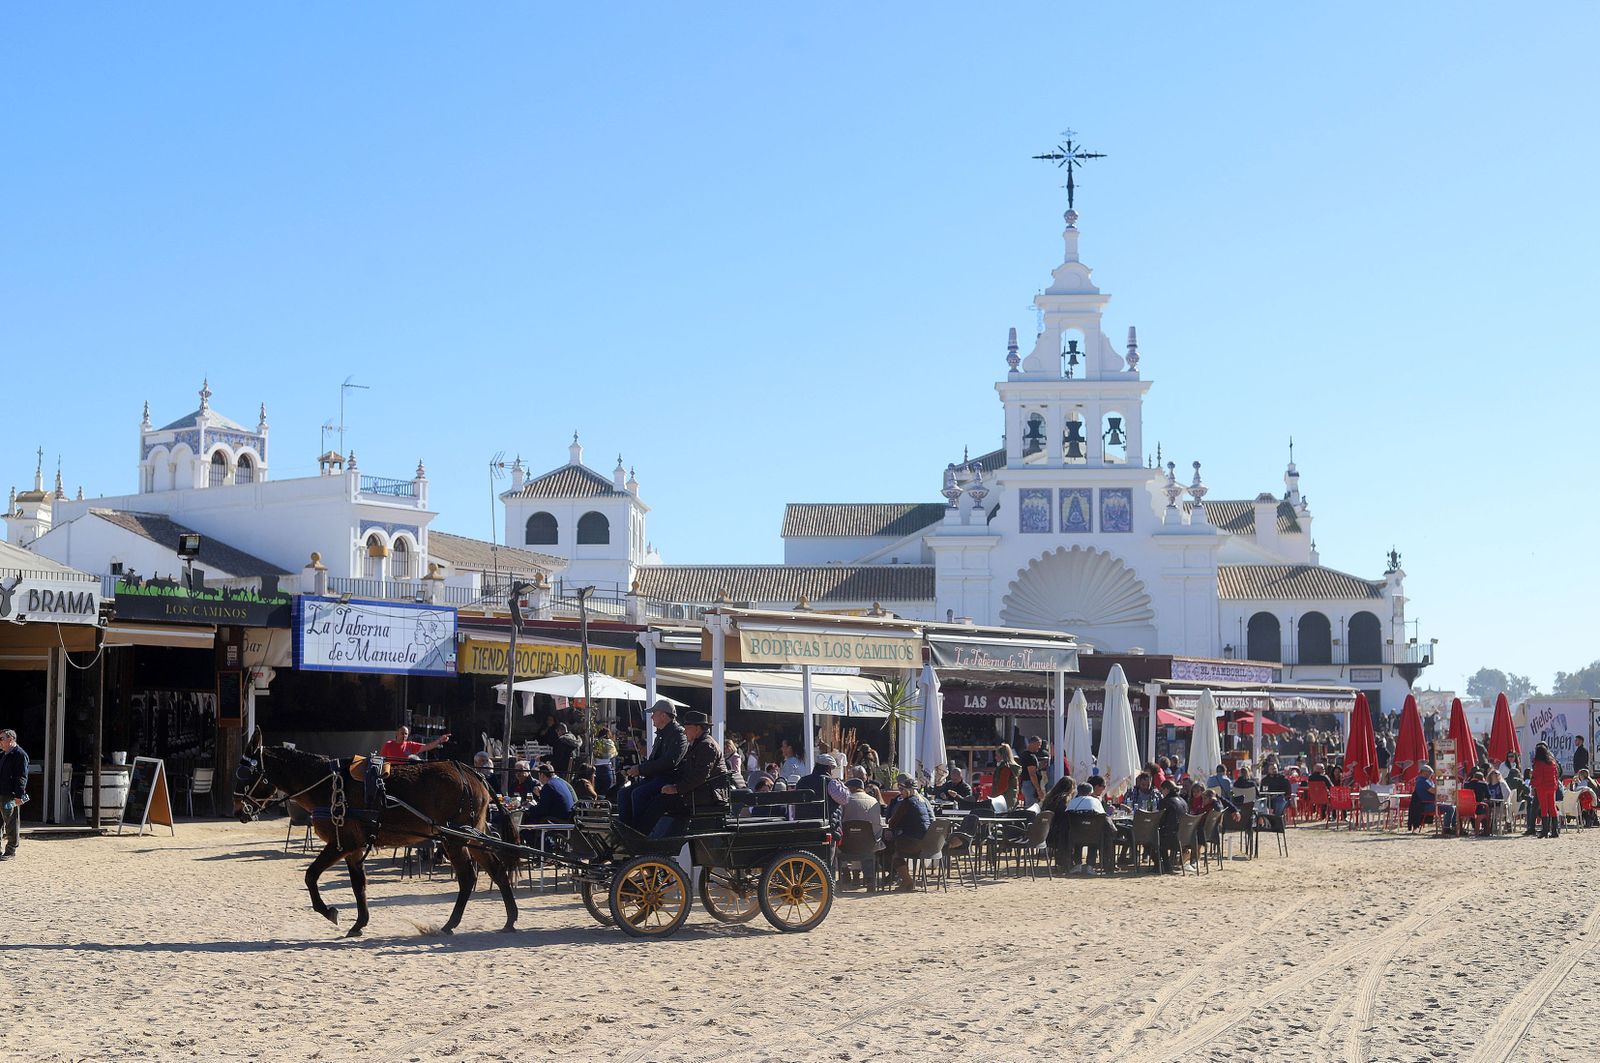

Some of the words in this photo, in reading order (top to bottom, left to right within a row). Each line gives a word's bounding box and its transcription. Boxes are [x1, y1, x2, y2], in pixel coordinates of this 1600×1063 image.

[28, 588, 96, 615] BRAMA
[165, 603, 188, 615] LOS
[192, 605, 248, 619] CAMINOS
[306, 603, 331, 636] La
[334, 606, 390, 638] Taberna
[328, 641, 343, 662] de
[345, 637, 417, 664] Manuela
[750, 638, 820, 658] BODEGAS
[823, 641, 851, 659] LOS
[855, 642, 914, 661] CAMINOS
[954, 646, 969, 666] La
[1006, 654, 1017, 669] de
[1017, 648, 1057, 670] Manuela
[564, 653, 607, 675] DOANA
[1200, 666, 1210, 675] EL
[1211, 666, 1247, 678] TAMBORIL
[963, 695, 988, 709] LAS
[1220, 696, 1250, 709] CARRETAS
[1530, 707, 1554, 736] Hielos
